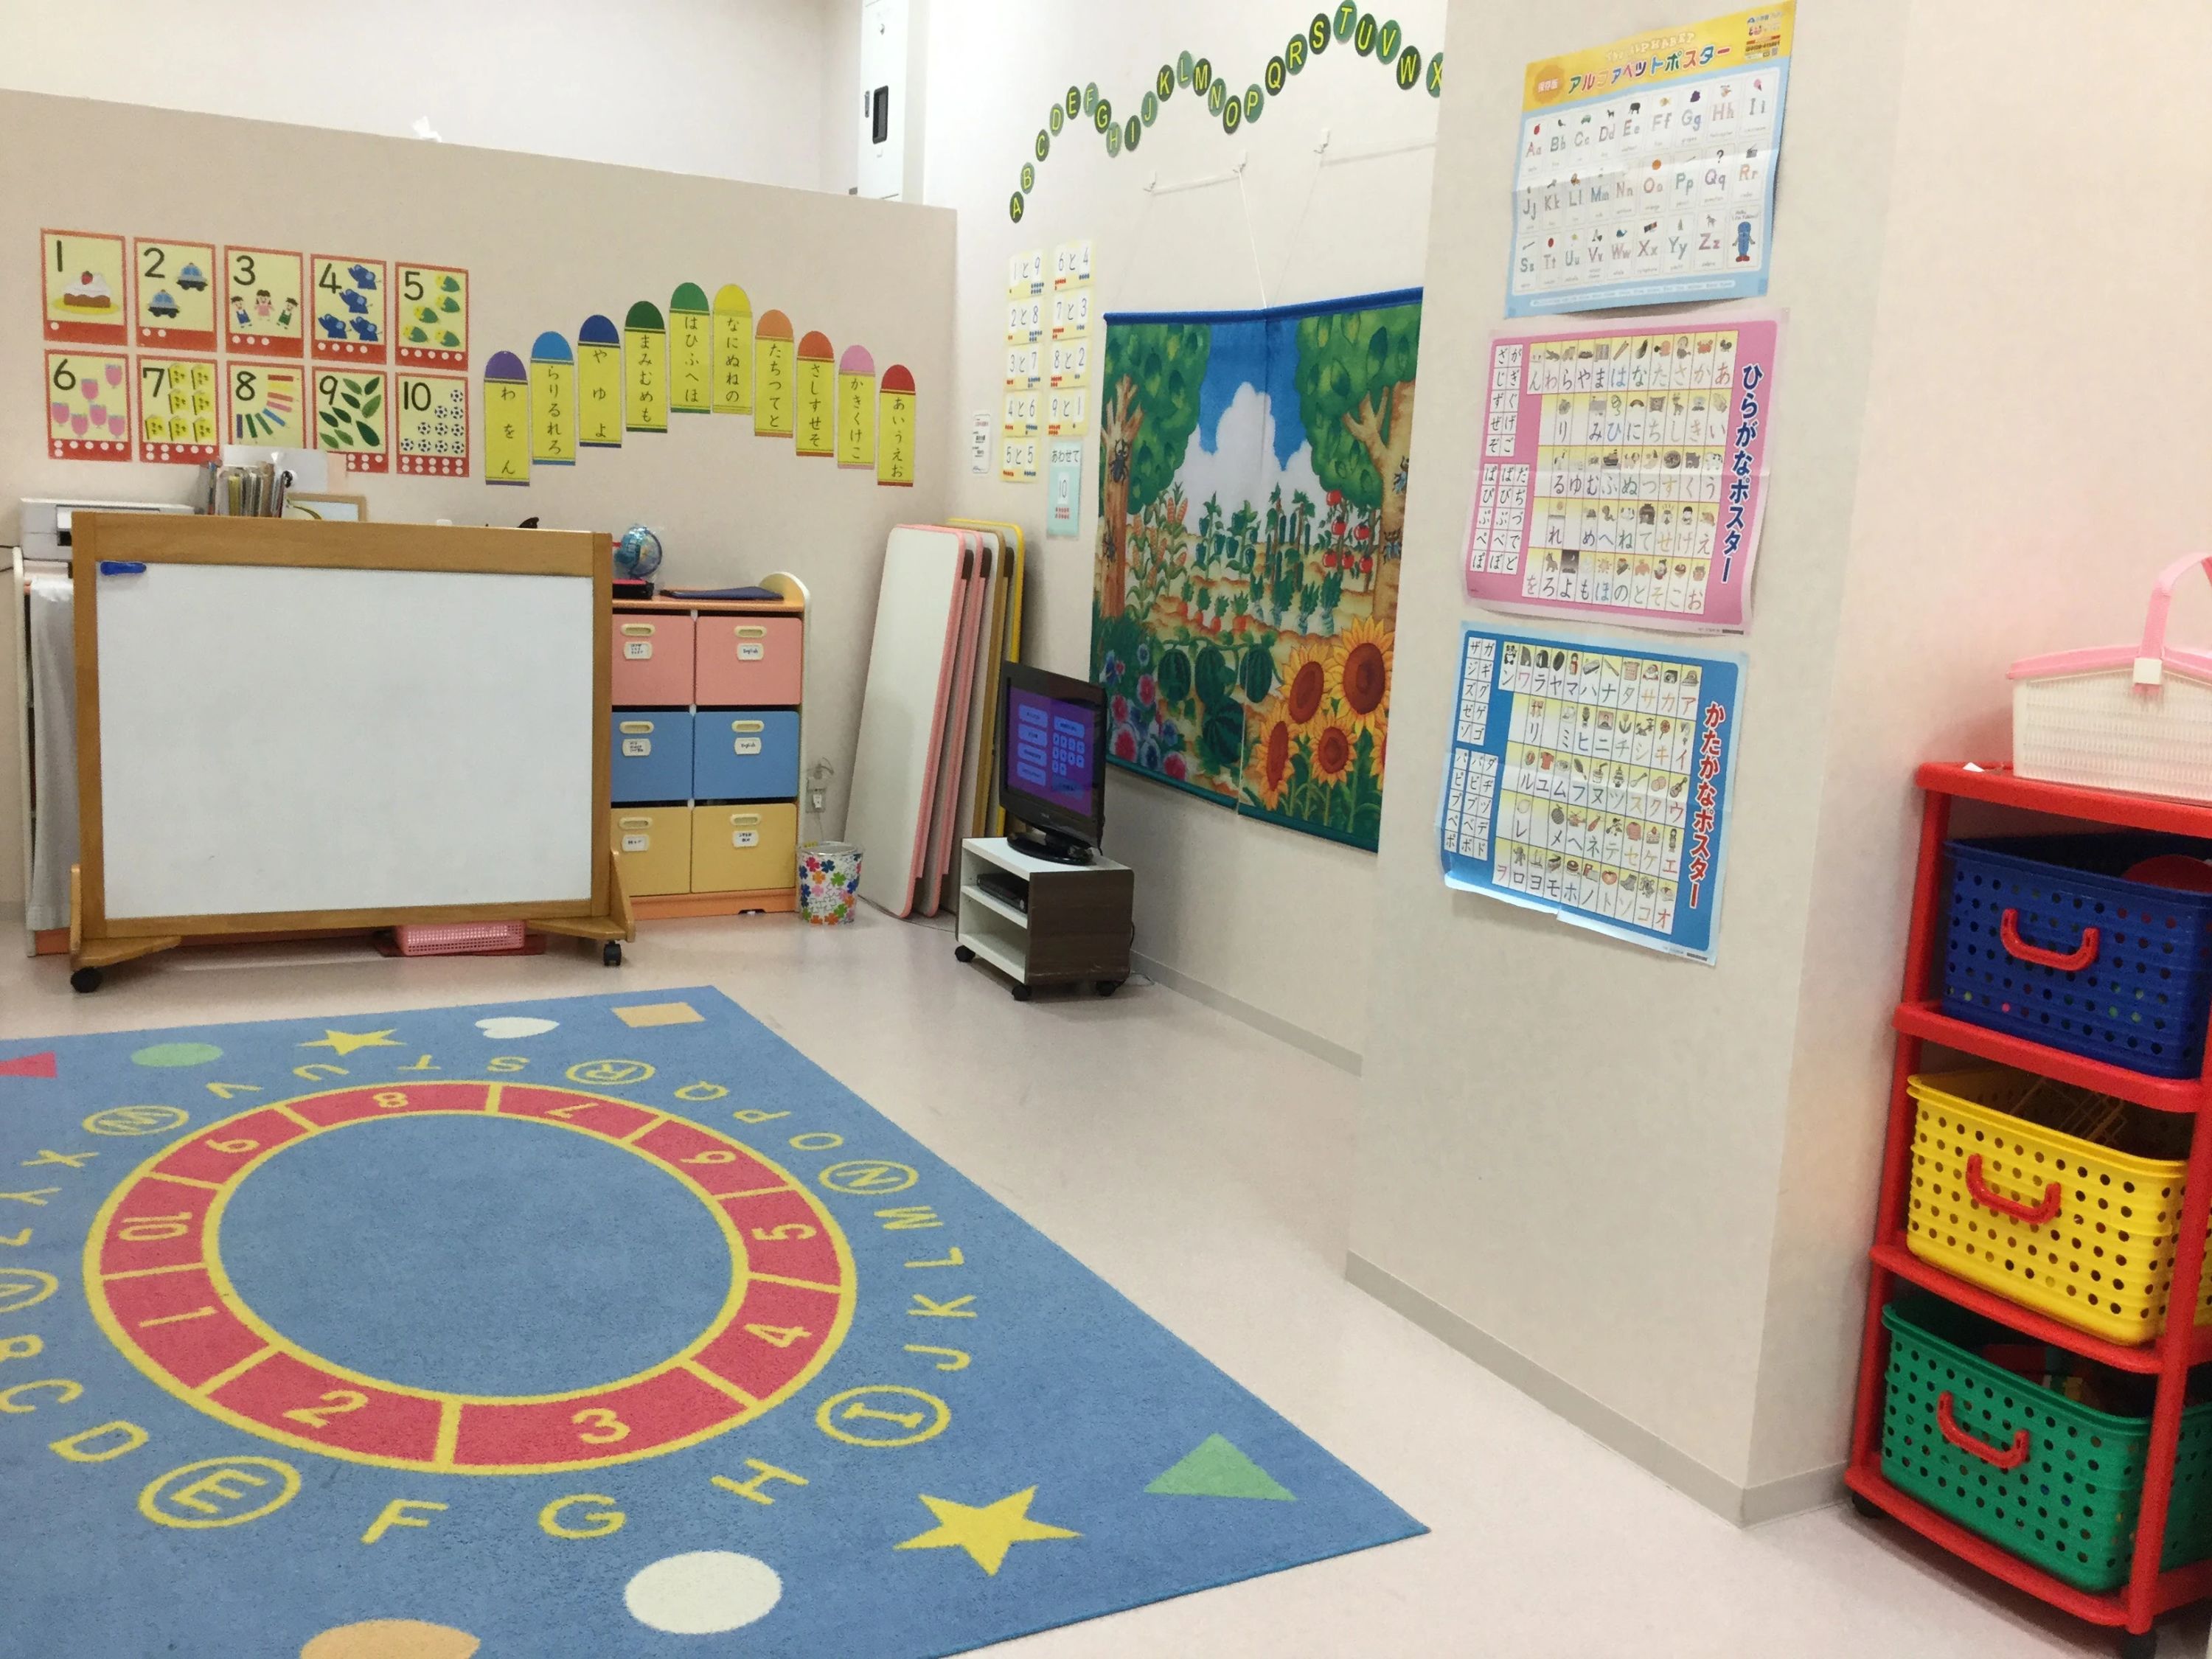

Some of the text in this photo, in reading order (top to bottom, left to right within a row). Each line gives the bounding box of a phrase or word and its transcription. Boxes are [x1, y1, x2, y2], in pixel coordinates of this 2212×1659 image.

[1012, 7, 1443, 218] A B C D E F G H I J K L M N O P Q R S T U V W X
[1526, 98, 1765, 158] Aa Bb Cc Dd Ee Ff Gg Hh Ii
[1523, 164, 1759, 220] Jj Kk Ll Mm Nn Oo Pp Qq Rr
[1520, 233, 1720, 272] Ss Tt Uu Vv Ww Xx Yy Zz
[55, 240, 424, 301] 1 2 3 4 5
[54, 358, 431, 411] 6 7 8 9 10
[1529, 363, 1730, 390] ん わ ら や ま は な た さ か あ
[1722, 364, 1763, 583] ひらがなポスター
[1059, 479, 1068, 499] 10
[1503, 670, 1696, 714] ン ワ ラ ヤ マ ハ ナ タ サ カ ア
[1690, 703, 1725, 908] かたかなポスター
[293, 1063, 349, 1082] U
[398, 1054, 441, 1071] T
[487, 1056, 530, 1073] S
[205, 1082, 263, 1099] V
[373, 1092, 408, 1107] 8
[674, 1081, 728, 1100] Q
[544, 1102, 599, 1119] 7
[734, 1109, 791, 1124] P
[790, 1133, 844, 1150] O
[21, 1150, 100, 1167] X
[119, 1211, 192, 1241] 10
[874, 1206, 943, 1230] M
[752, 1222, 817, 1242] 5
[904, 1247, 964, 1267] L
[138, 1306, 217, 1328] 1
[908, 1293, 978, 1318] K
[745, 1322, 812, 1347] 4
[903, 1343, 973, 1370] J
[0, 1379, 83, 1413] C
[283, 1390, 369, 1428] 2
[571, 1408, 630, 1444] 3
[49, 1420, 148, 1462] D
[711, 1458, 809, 1505] H
[360, 1498, 448, 1544] F
[538, 1493, 626, 1540] G
